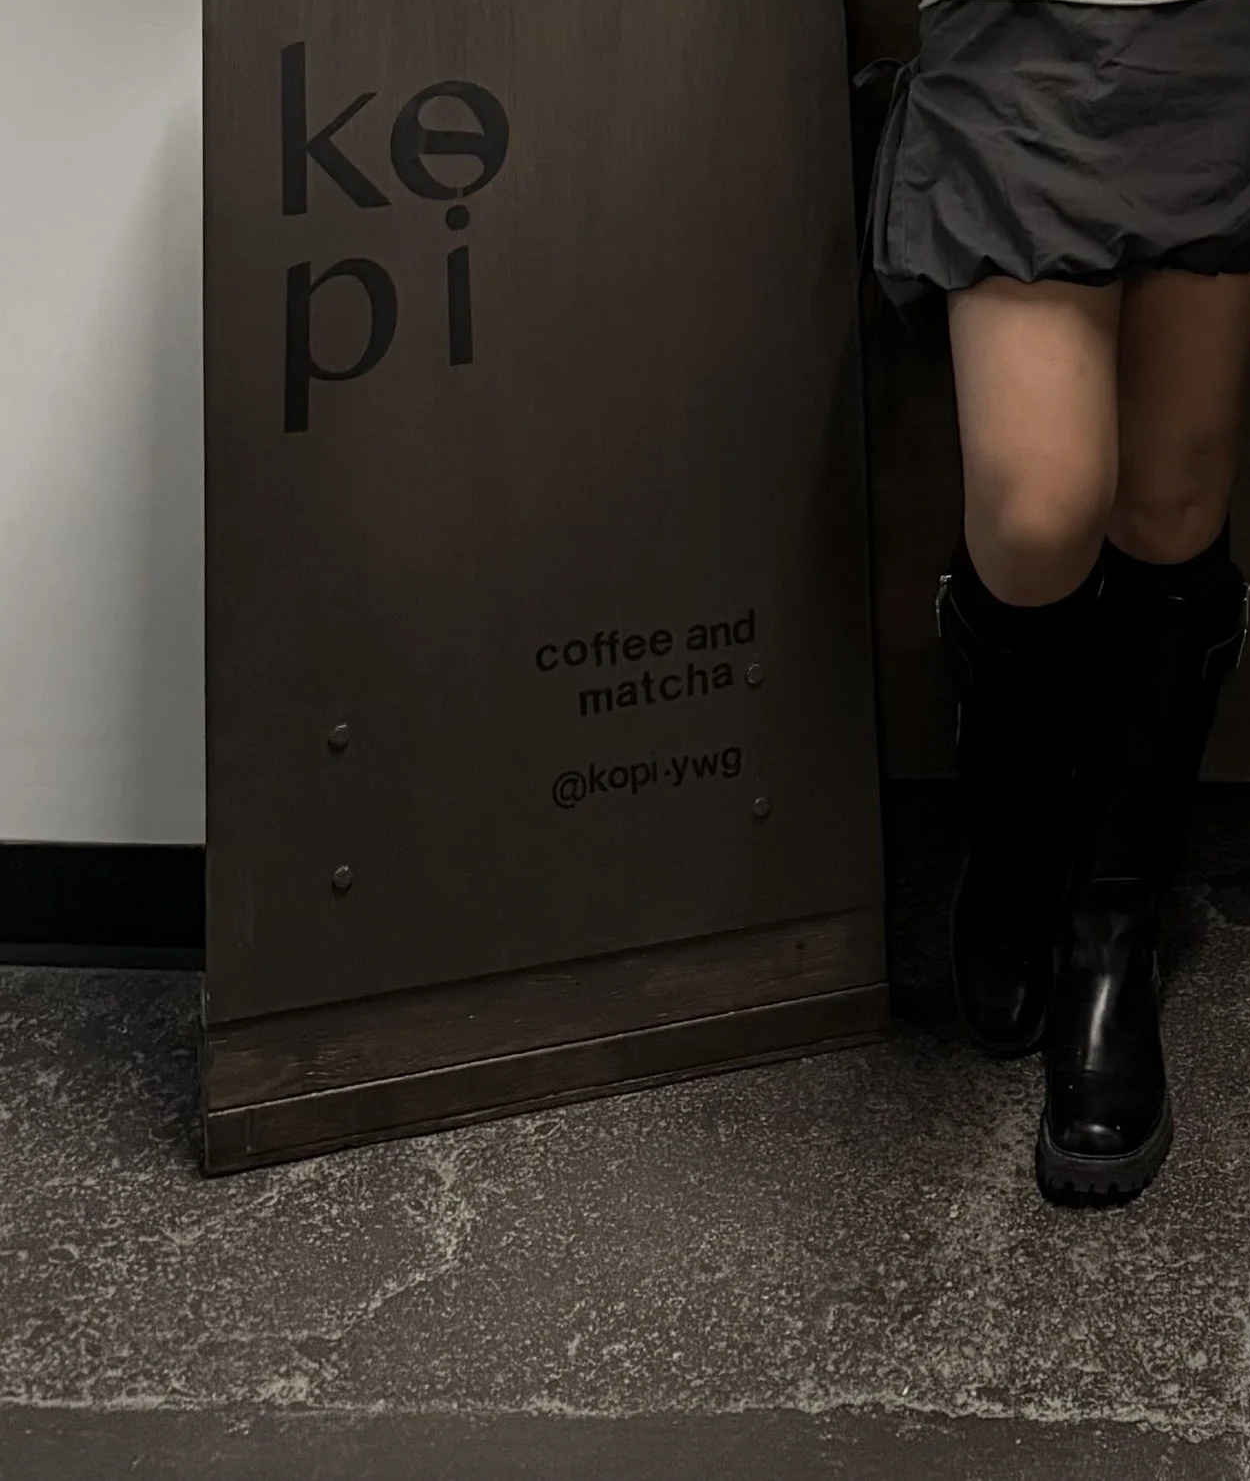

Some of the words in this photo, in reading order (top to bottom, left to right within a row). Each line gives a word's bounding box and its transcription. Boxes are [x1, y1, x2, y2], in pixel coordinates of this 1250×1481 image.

[535, 629, 674, 672] coffee
[686, 608, 756, 651] and
[578, 661, 734, 717] matcha
